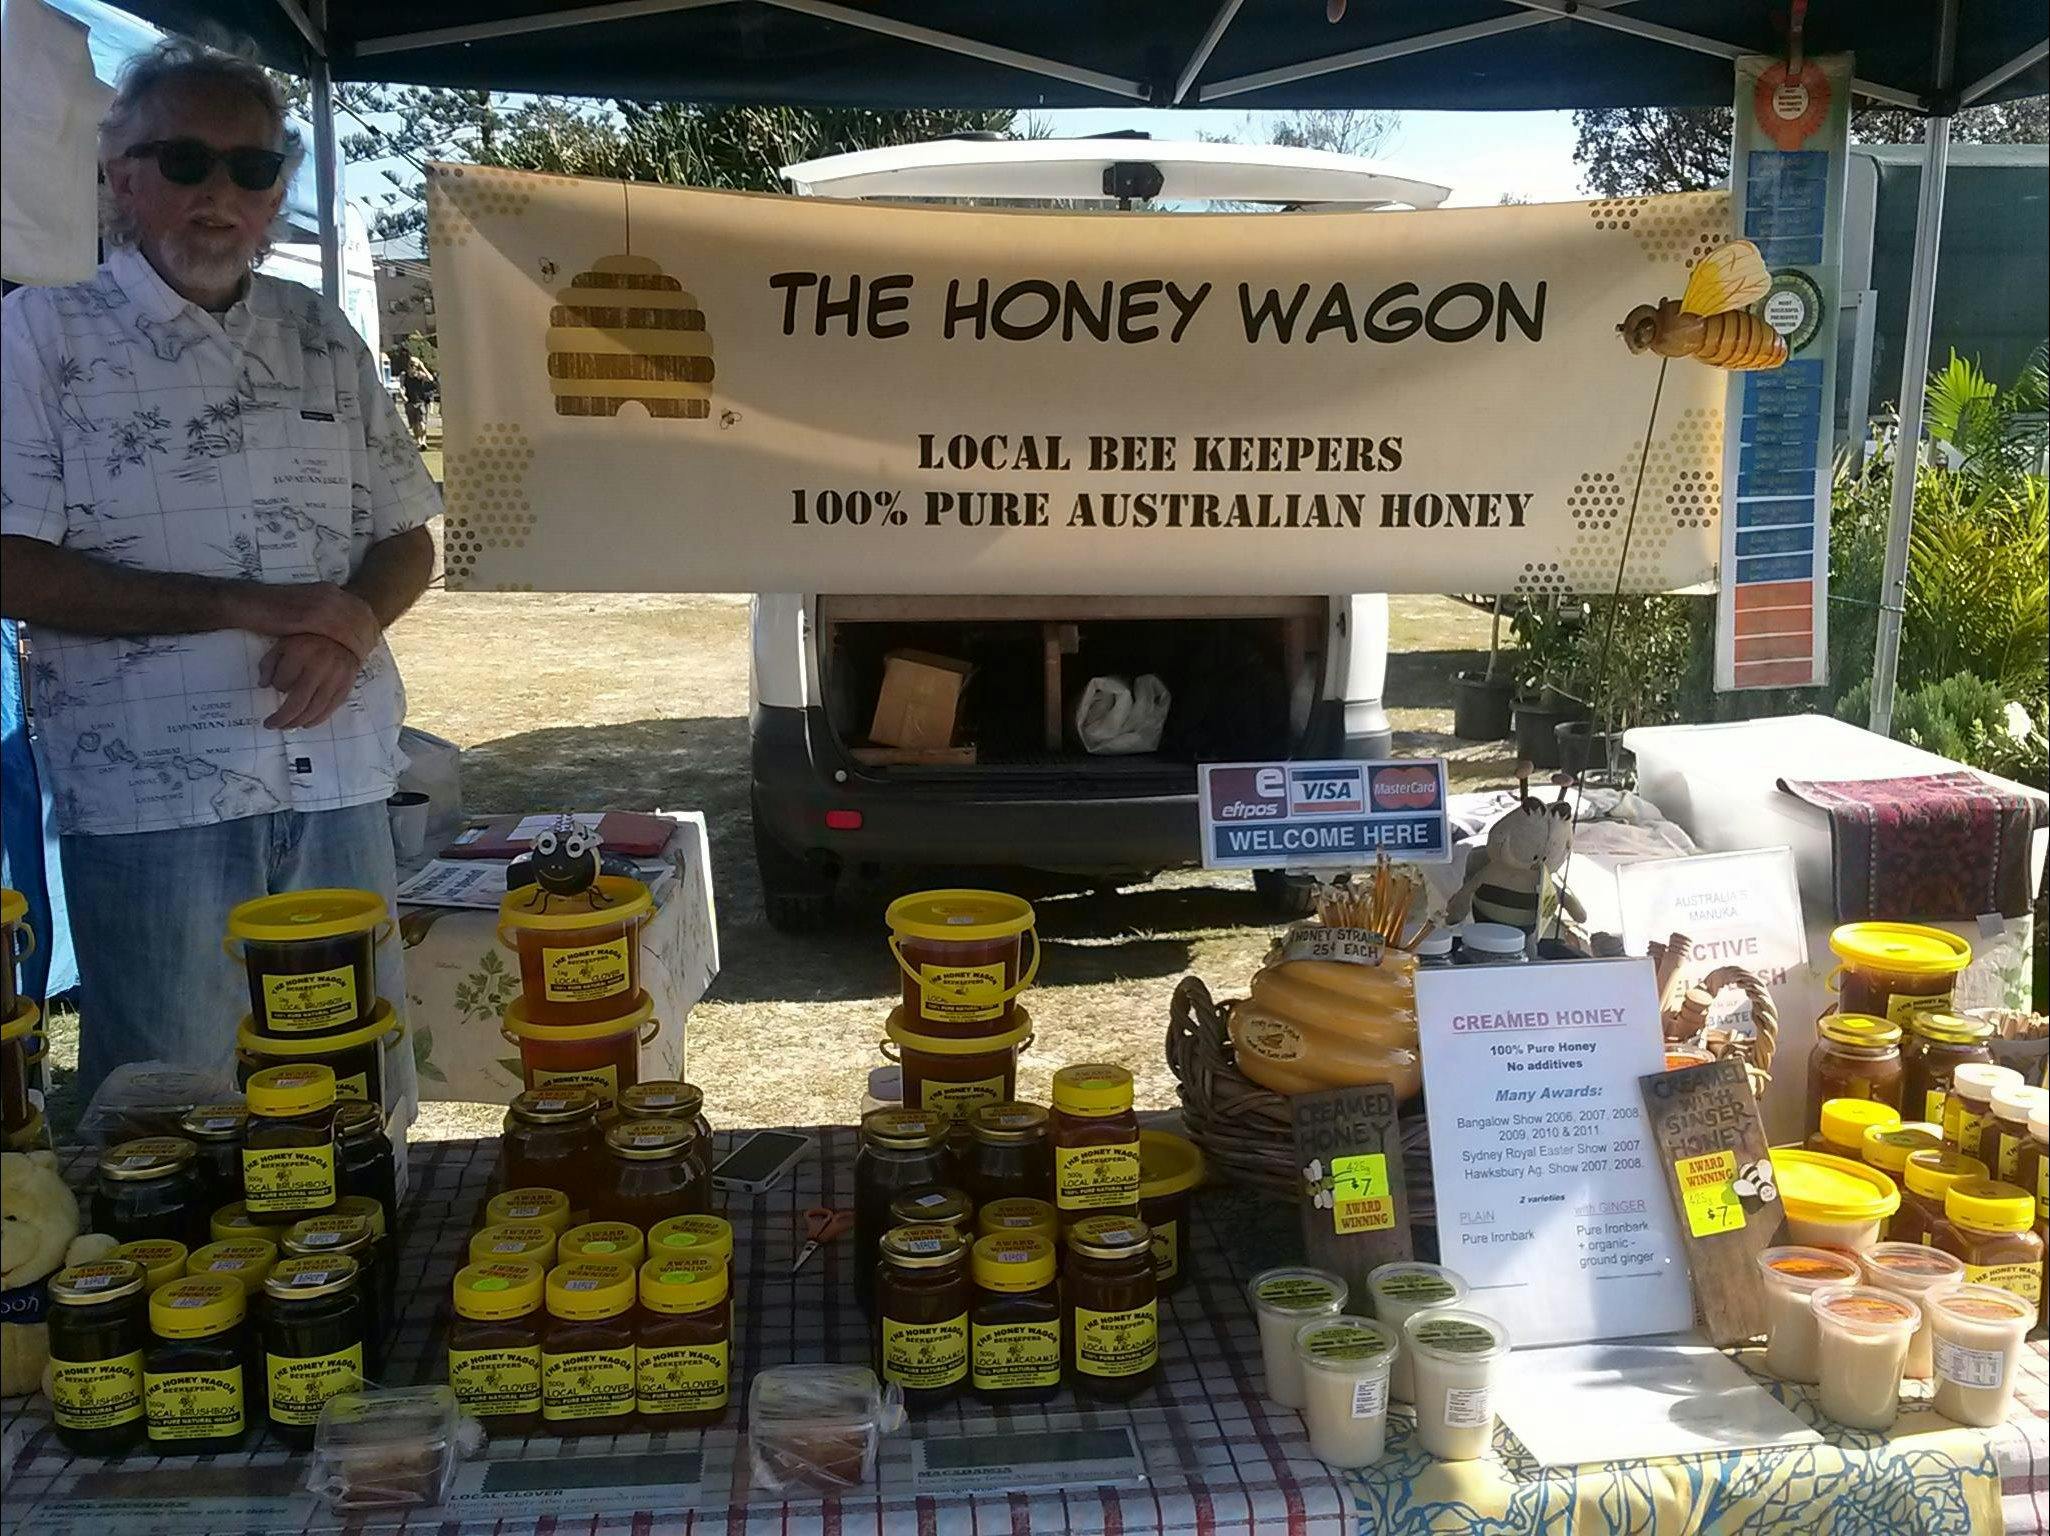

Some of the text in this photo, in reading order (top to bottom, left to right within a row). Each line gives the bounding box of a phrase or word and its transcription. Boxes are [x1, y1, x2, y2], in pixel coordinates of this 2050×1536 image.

[769, 272, 1548, 345] THE HONEY WAGON
[917, 433, 1403, 472] LOCAL BEE KEEPERS
[791, 489, 1535, 528] 100% PURE AUSTRALIAN HONEY
[1302, 782, 1351, 800] VISA
[1374, 781, 1435, 795] MasterCard
[1222, 801, 1278, 818] eftpos
[1229, 824, 1428, 850] WELCOME HERE
[1689, 910, 1738, 921] MANUKA
[1296, 929, 1332, 942] HONEY
[1344, 944, 1378, 958] EACH
[553, 951, 595, 969] THE HONEY
[271, 982, 285, 994] THE
[286, 977, 315, 986] HONEY
[1452, 1008, 1626, 1031] CREAMED HONEY
[1490, 1042, 1597, 1056] 100% Pure Honey
[1507, 1059, 1583, 1072] No additives
[1495, 1085, 1602, 1103] Many Awards:
[1457, 1116, 1509, 1130] Bangalow
[1513, 1114, 1542, 1125] Show
[1532, 1127, 1559, 1139] 2010
[1562, 1126, 1570, 1137] &
[1064, 1149, 1111, 1169] THE HONEY
[1462, 1151, 1503, 1163] Sydney
[1506, 1147, 1536, 1161] Royal
[1539, 1144, 1575, 1156] Easter
[1577, 1142, 1607, 1154] Show
[260, 1153, 328, 1169] HONEY WAGON
[1688, 1157, 1724, 1173] AWARD
[1465, 1166, 1524, 1180] Hawksbury
[1549, 1163, 1578, 1174] Show
[1686, 1169, 1733, 1188] WINNING
[1063, 1179, 1089, 1187] LOCAL
[1519, 1193, 1565, 1203] 2 varieties
[1345, 1200, 1381, 1215] AWARD
[1573, 1199, 1647, 1213] with GINGER
[1341, 1213, 1388, 1229] WINNING
[1459, 1210, 1495, 1222] PLAIN
[584, 1229, 625, 1238] AWARD
[903, 1228, 943, 1236] AWARD
[1576, 1219, 1649, 1236] Pure Ironbark
[994, 1239, 1035, 1247] AWARD
[1462, 1229, 1536, 1245] Pure Ironbark
[1588, 1238, 1629, 1252] organic
[665, 1259, 708, 1267] AWARD
[1580, 1250, 1655, 1268] ground ginger
[576, 1264, 619, 1272] AWARD
[660, 1265, 712, 1273] WINNING
[1989, 1266, 2017, 1276] HONEY
[1100, 1314, 1131, 1323] HONEY
[890, 1327, 938, 1342] THE HONEY
[977, 1327, 1058, 1347] THE HONEY WAGON
[453, 1353, 541, 1375] THE HONEY WAGON
[546, 1355, 632, 1377] THE HONEY WAGON
[653, 1351, 721, 1368] HONEY WAGON
[889, 1354, 913, 1364] LOCAL
[976, 1354, 1058, 1366] LOCAL MACADAMIA
[64, 1366, 135, 1379] HONEY WAGON
[274, 1367, 288, 1379] THE
[290, 1361, 324, 1371] HONEY
[163, 1377, 236, 1394] HONEY WAGON
[500, 1382, 537, 1392] CLOVER
[546, 1383, 629, 1397] LOCAL CLOVER
[681, 1379, 718, 1388] CLOVER
[179, 1405, 235, 1416] BRUSHBOX
